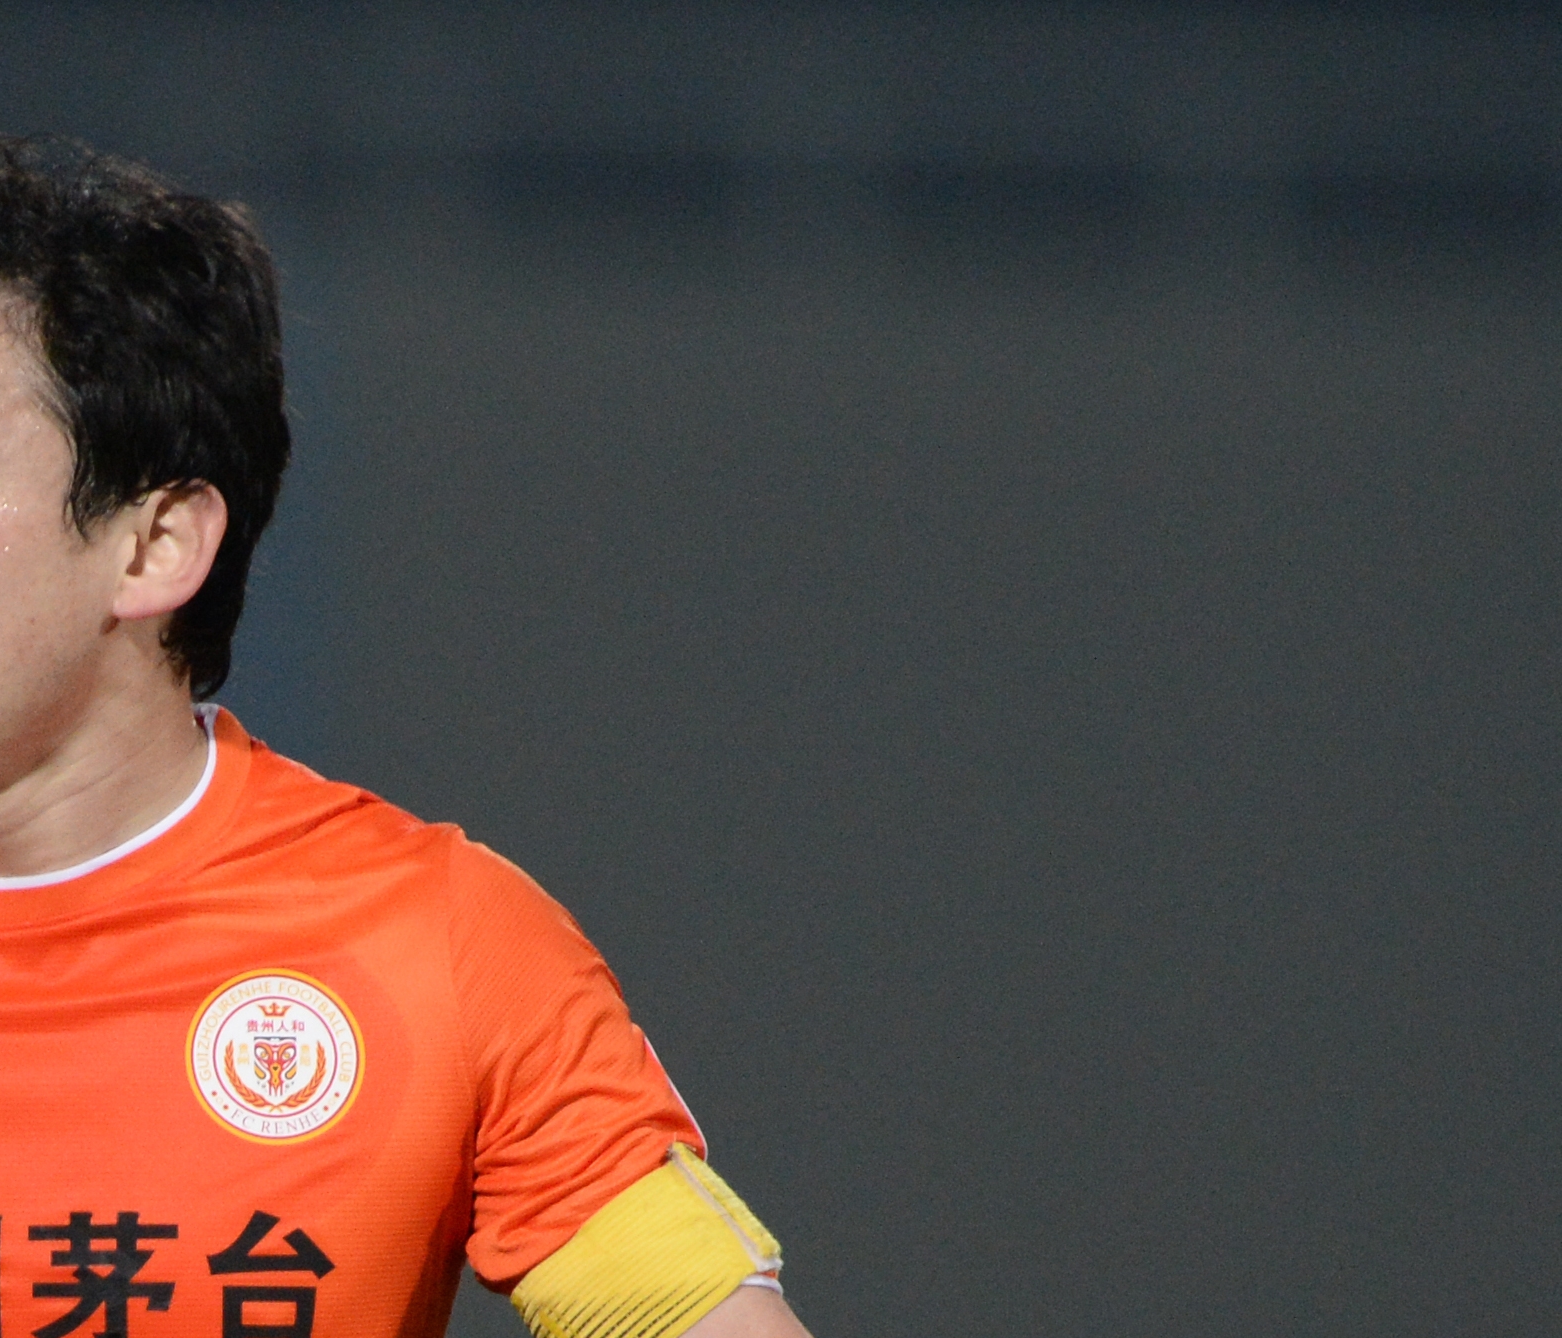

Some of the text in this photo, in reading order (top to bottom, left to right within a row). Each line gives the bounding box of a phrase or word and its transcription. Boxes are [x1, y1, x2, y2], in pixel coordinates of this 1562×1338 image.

[247, 1019, 305, 1033] 贵州人和
[278, 981, 347, 1037] FOOTBALL
[338, 1041, 353, 1083] CLUB
[230, 1107, 324, 1135] FC RENHE
